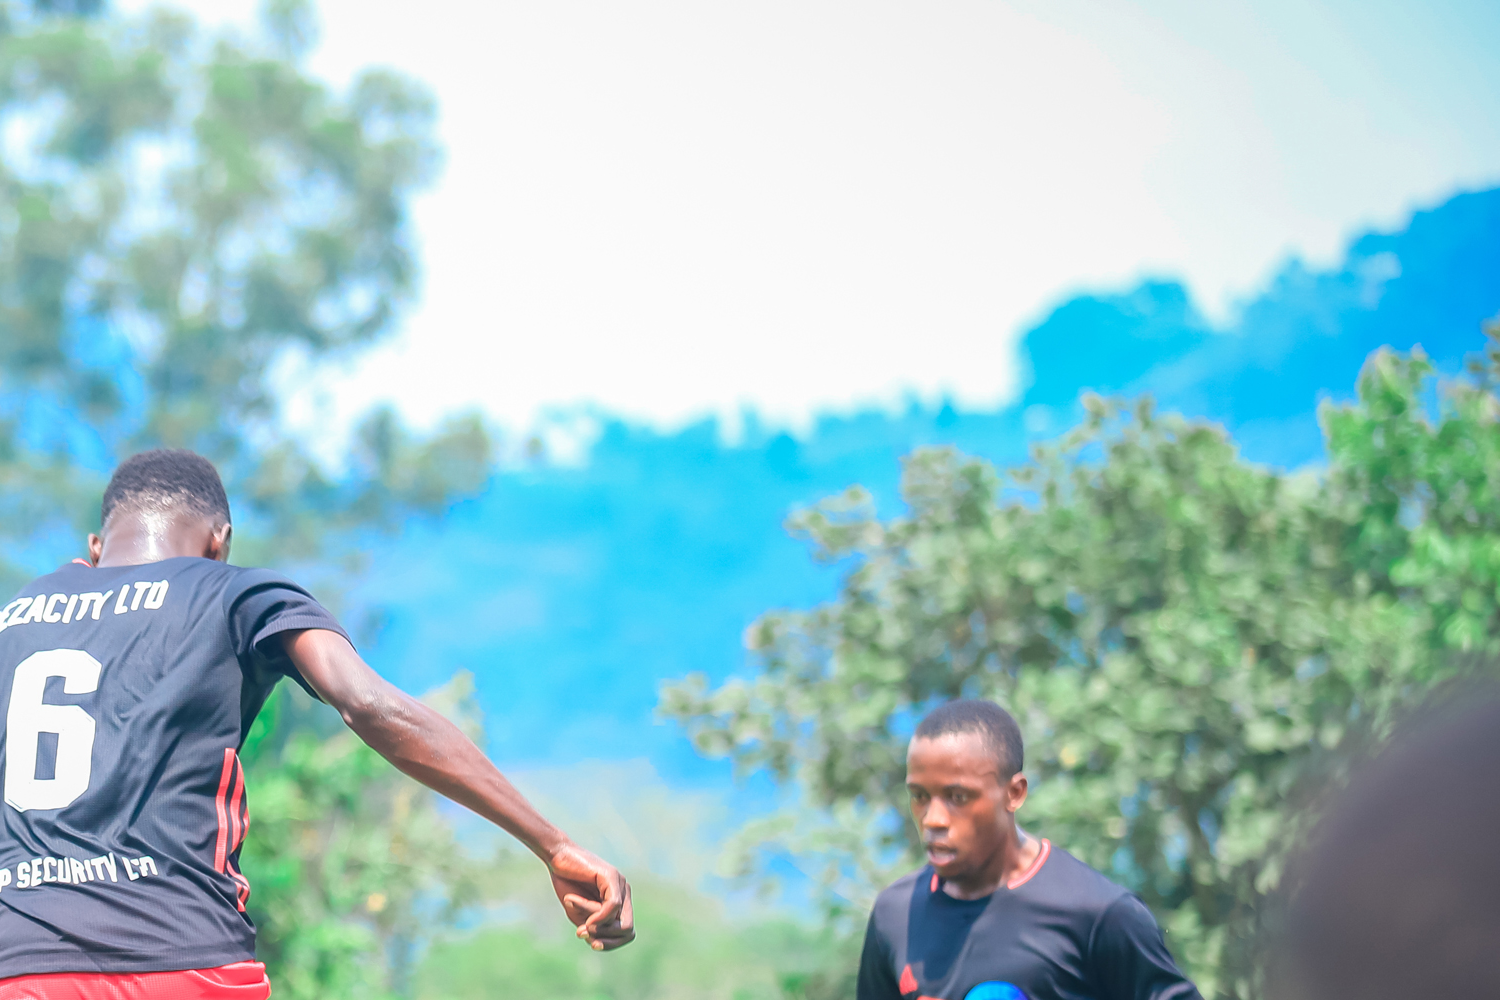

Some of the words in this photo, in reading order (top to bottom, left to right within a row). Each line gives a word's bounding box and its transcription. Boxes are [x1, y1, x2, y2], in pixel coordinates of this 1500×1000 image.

[113, 579, 170, 615] LTD
[4, 648, 102, 813] 6
[16, 852, 118, 889] SECURITY
